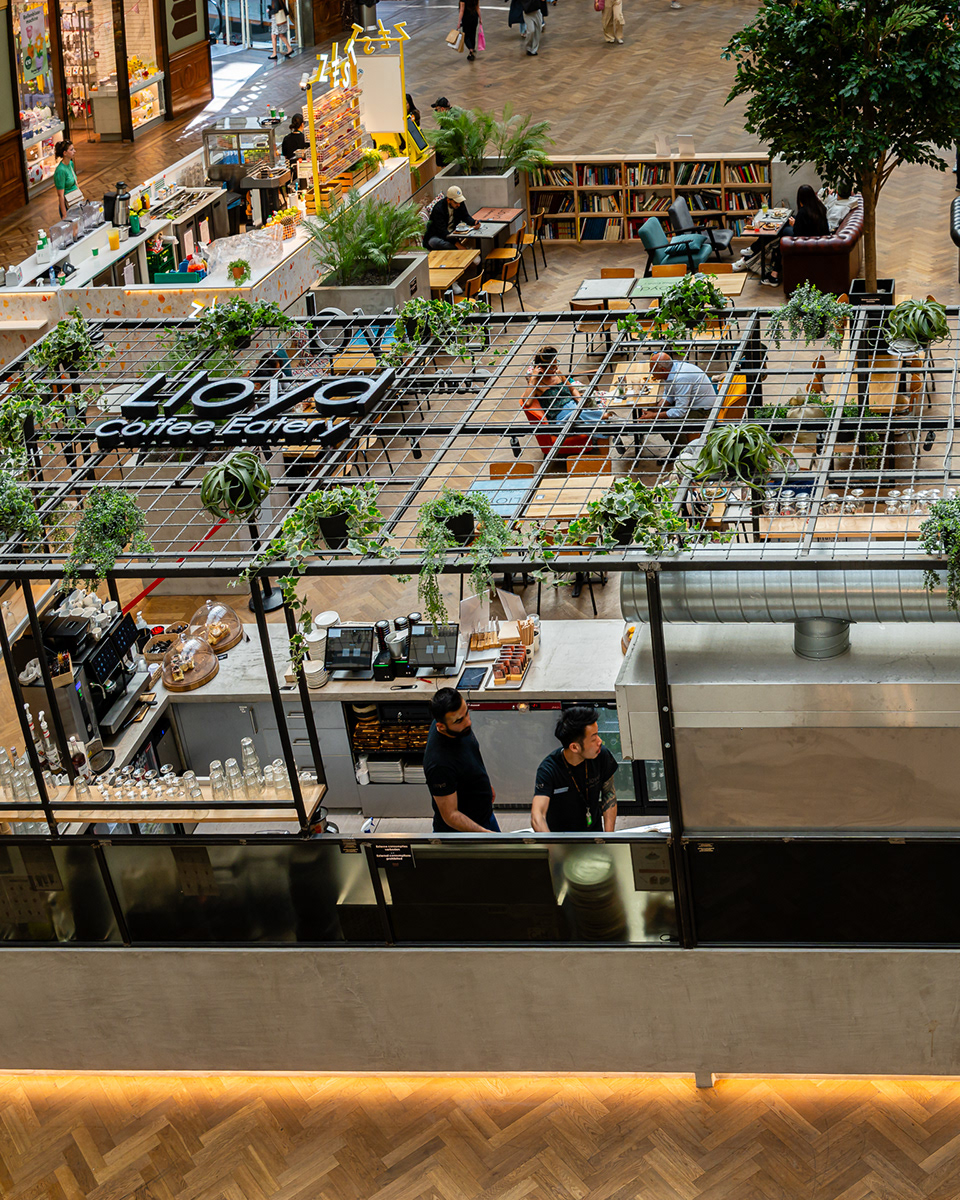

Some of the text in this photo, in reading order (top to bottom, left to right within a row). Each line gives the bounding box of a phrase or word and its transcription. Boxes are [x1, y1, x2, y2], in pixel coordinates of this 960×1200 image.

[121, 368, 397, 418] Lloyd
[95, 415, 350, 442] Coffee Eatery
